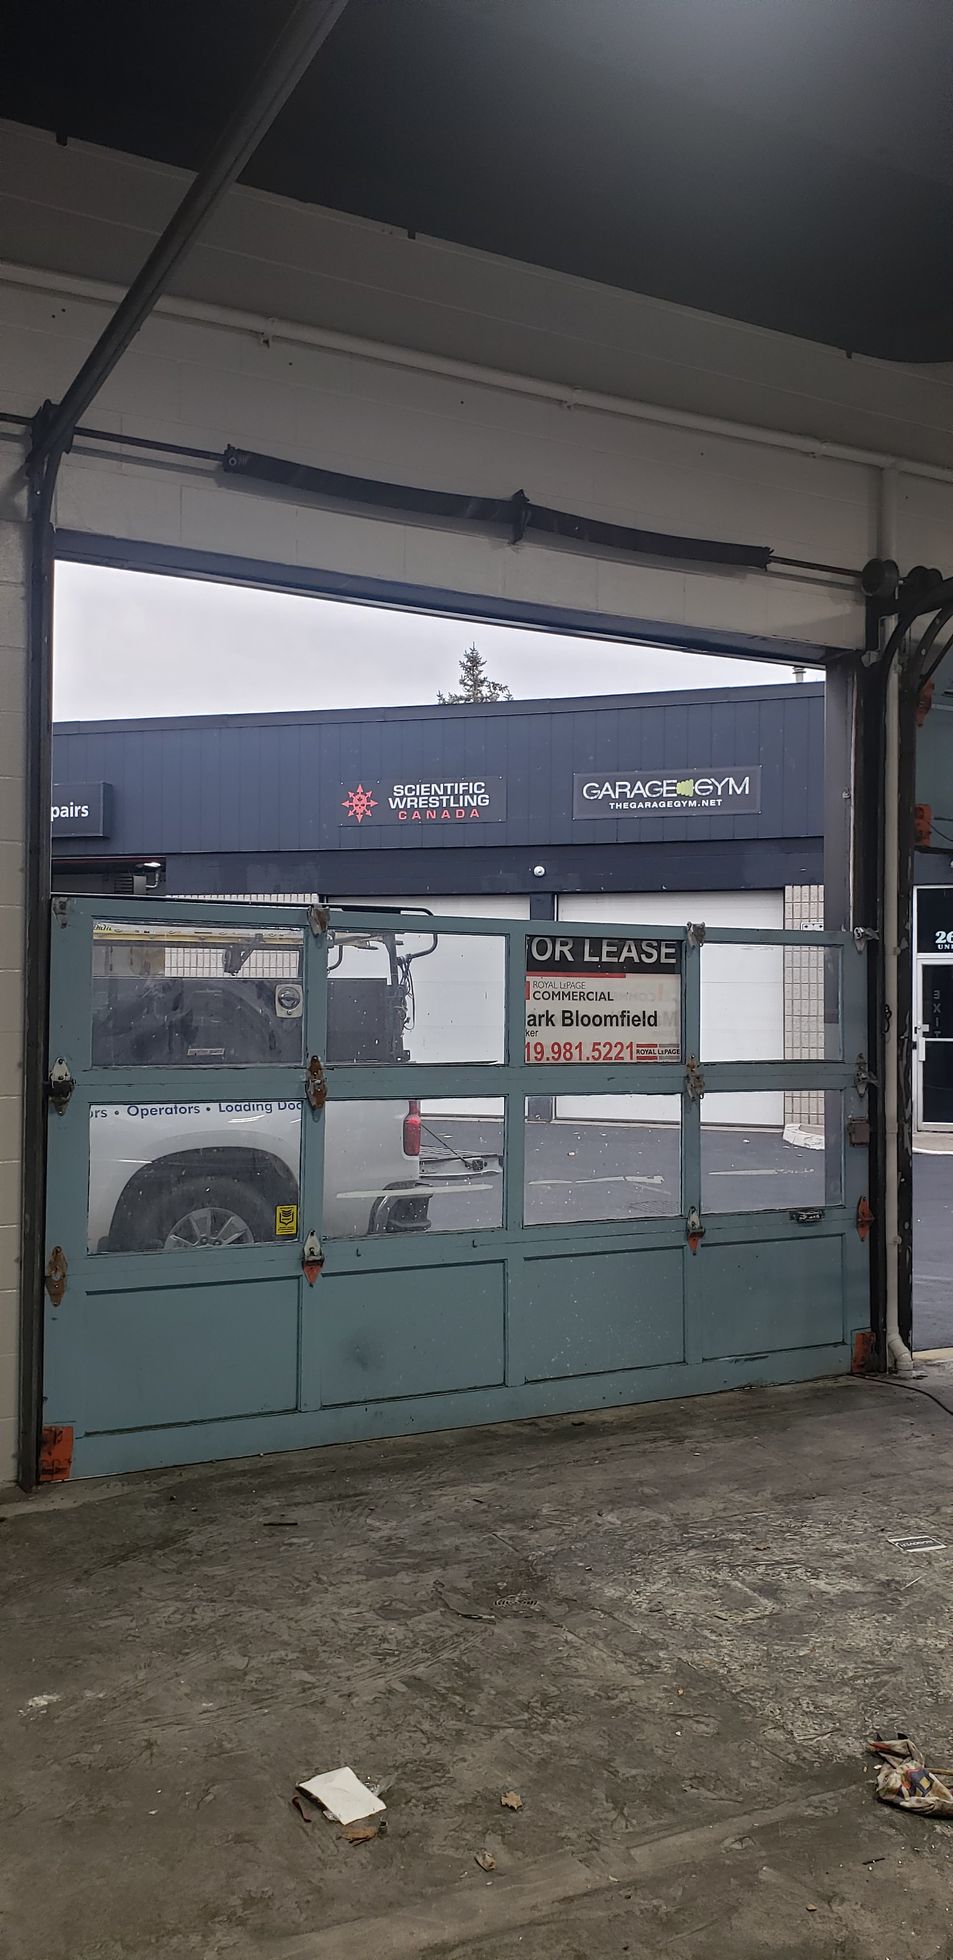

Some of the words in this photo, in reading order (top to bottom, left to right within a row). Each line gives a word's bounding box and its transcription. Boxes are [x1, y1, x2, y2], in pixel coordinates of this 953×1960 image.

[393, 782, 486, 797] SCIENTIFIC
[582, 779, 678, 800] GARAGE
[694, 776, 750, 796] GYM
[388, 794, 490, 809] WRESTLING
[609, 799, 723, 810] THEGARAGEGYM.NET
[51, 802, 89, 822] pairs
[398, 808, 480, 820] CANADA
[526, 936, 575, 962] OR
[583, 938, 677, 964] LEASE
[532, 980, 558, 989] ROYAL
[532, 990, 614, 1002] COMMERCIAL
[561, 1010, 658, 1027] Bloomfield
[127, 1105, 200, 1119] Operators
[218, 1101, 273, 1114] Loading
